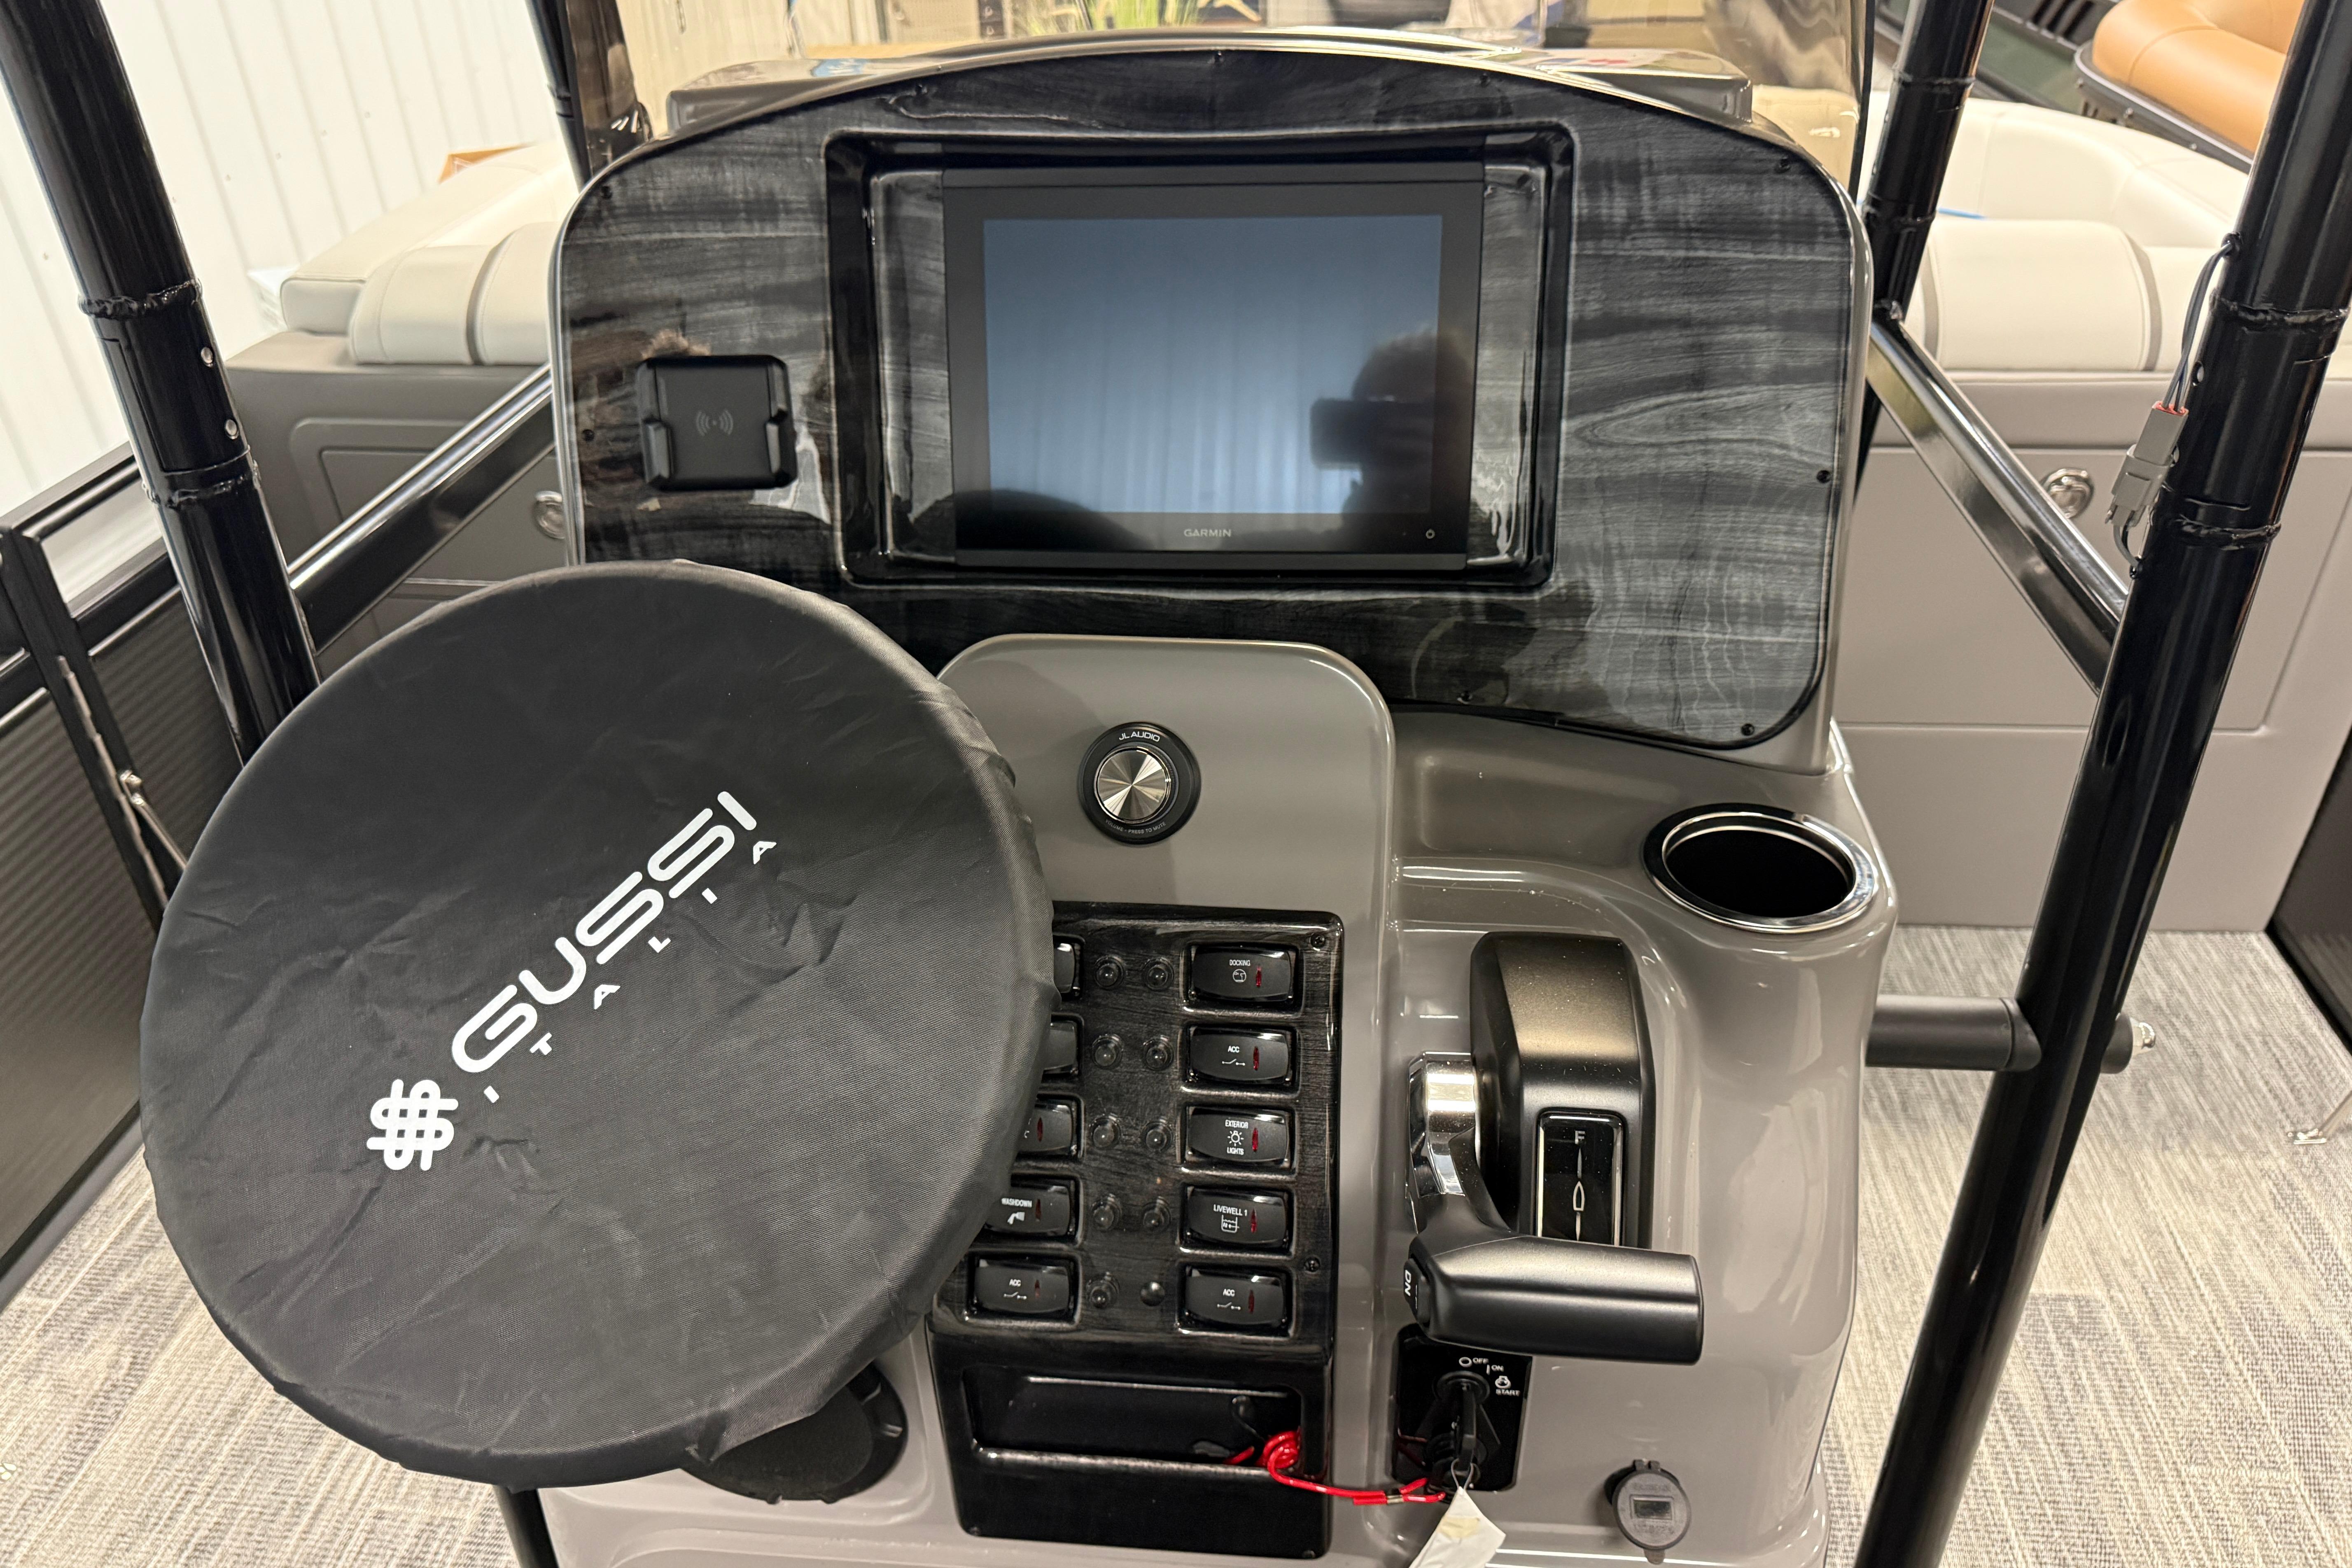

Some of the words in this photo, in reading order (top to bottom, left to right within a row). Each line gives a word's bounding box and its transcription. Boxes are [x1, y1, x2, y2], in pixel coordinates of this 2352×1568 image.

[1183, 528, 1232, 537] GARMIN
[1130, 731, 1160, 742] AUDIO
[1105, 819, 1124, 831] VOLUME
[1153, 821, 1166, 831] MUTE
[452, 791, 757, 1073] GUSSI
[1225, 1119, 1248, 1129] EXTERIOR
[1575, 1131, 1585, 1144] F
[1227, 1147, 1244, 1155] LIGHTS
[1001, 1197, 1032, 1208] WASHDOWN
[1213, 1204, 1243, 1216] LIVEWELL
[1009, 1279, 1021, 1287] ACC
[1405, 1269, 1412, 1297] DN
[1223, 1288, 1235, 1297] ACC
